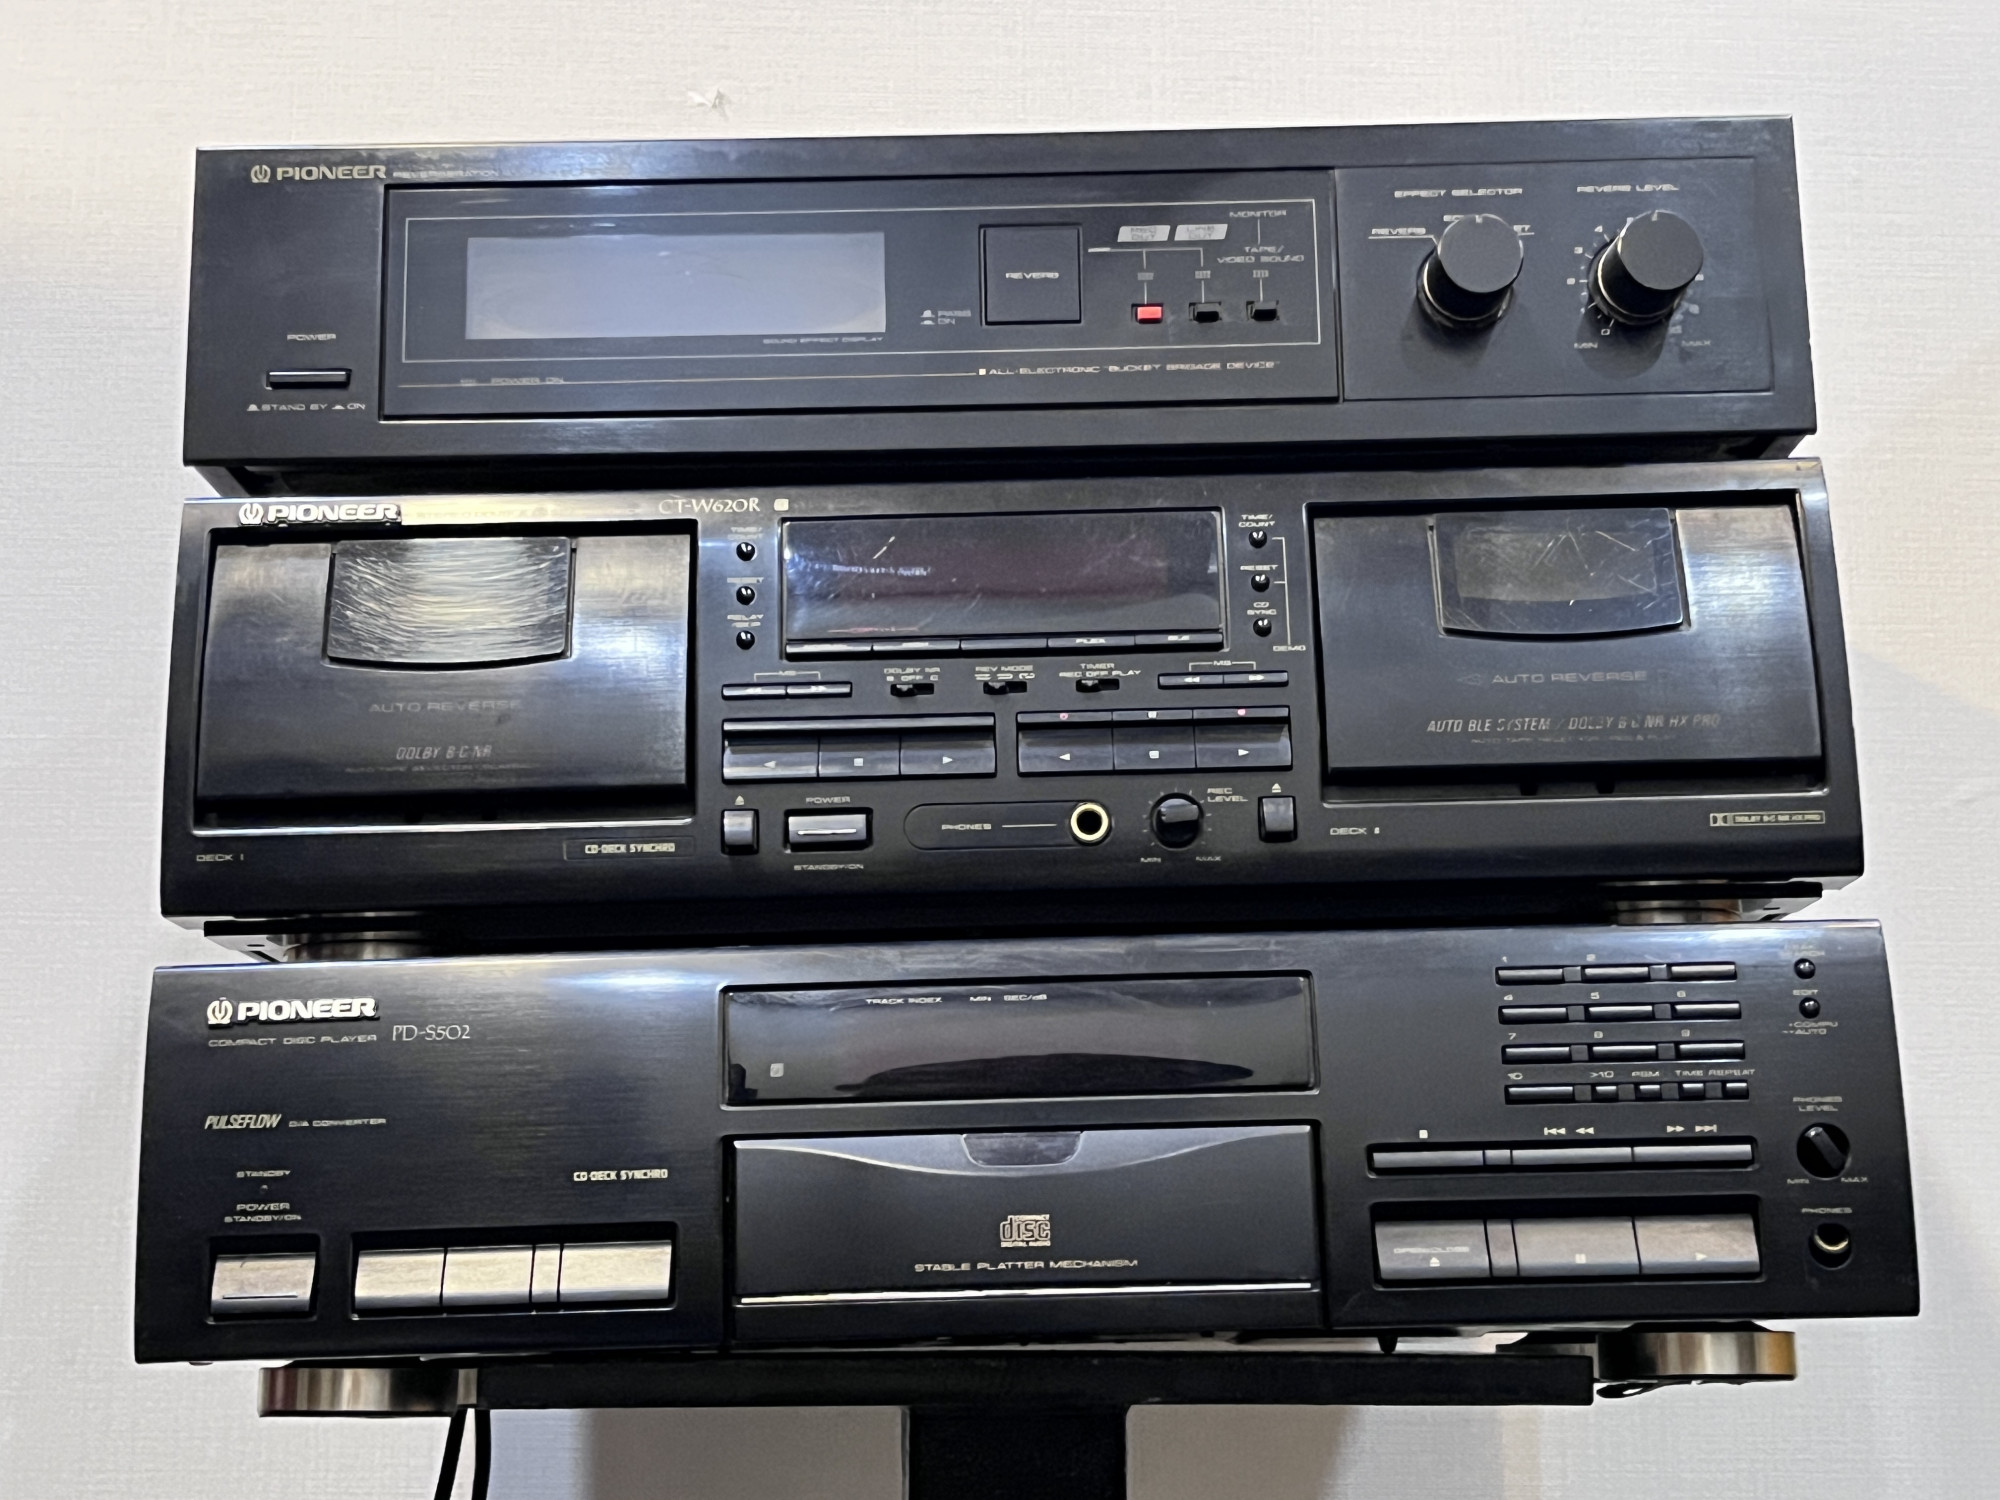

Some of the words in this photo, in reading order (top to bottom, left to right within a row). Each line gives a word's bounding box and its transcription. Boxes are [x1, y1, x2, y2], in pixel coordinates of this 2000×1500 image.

[275, 165, 387, 181] PIONEER
[1636, 183, 1680, 192] LEVEL
[1005, 271, 1060, 280] REVERB
[658, 497, 761, 514] CT-W620R
[266, 502, 400, 523] PIONEER
[1491, 673, 1545, 684] AUTO
[1550, 671, 1648, 682] REVERSE
[369, 703, 421, 713] AUTO
[427, 700, 522, 712] REVERSE
[1426, 719, 1463, 732] AUTO
[1467, 718, 1493, 732] BLE
[395, 746, 440, 761] DOLBY
[1206, 787, 1233, 795] REC
[805, 796, 851, 804] POWER
[1206, 795, 1248, 803] LEVEL
[941, 823, 992, 831] PHONES
[1329, 827, 1368, 836] DECK
[196, 853, 233, 862] DECK
[236, 997, 377, 1021] PIONEER
[391, 1024, 471, 1042] PD-S502
[208, 1037, 278, 1048] COMPACT
[283, 1036, 316, 1045] DISC
[320, 1034, 378, 1043] PLAYER
[1675, 1069, 1704, 1077] TIME
[1798, 1104, 1839, 1112] LEVEL
[204, 1113, 282, 1130] PULSEFLOW
[312, 1118, 387, 1127] CONVERTER
[620, 1168, 669, 1180] SYNCHRO
[236, 1202, 291, 1212] POWER
[914, 1262, 972, 1273] STABLE
[976, 1260, 1045, 1271] PLATTER
[1049, 1258, 1139, 1270] MECHANISM
